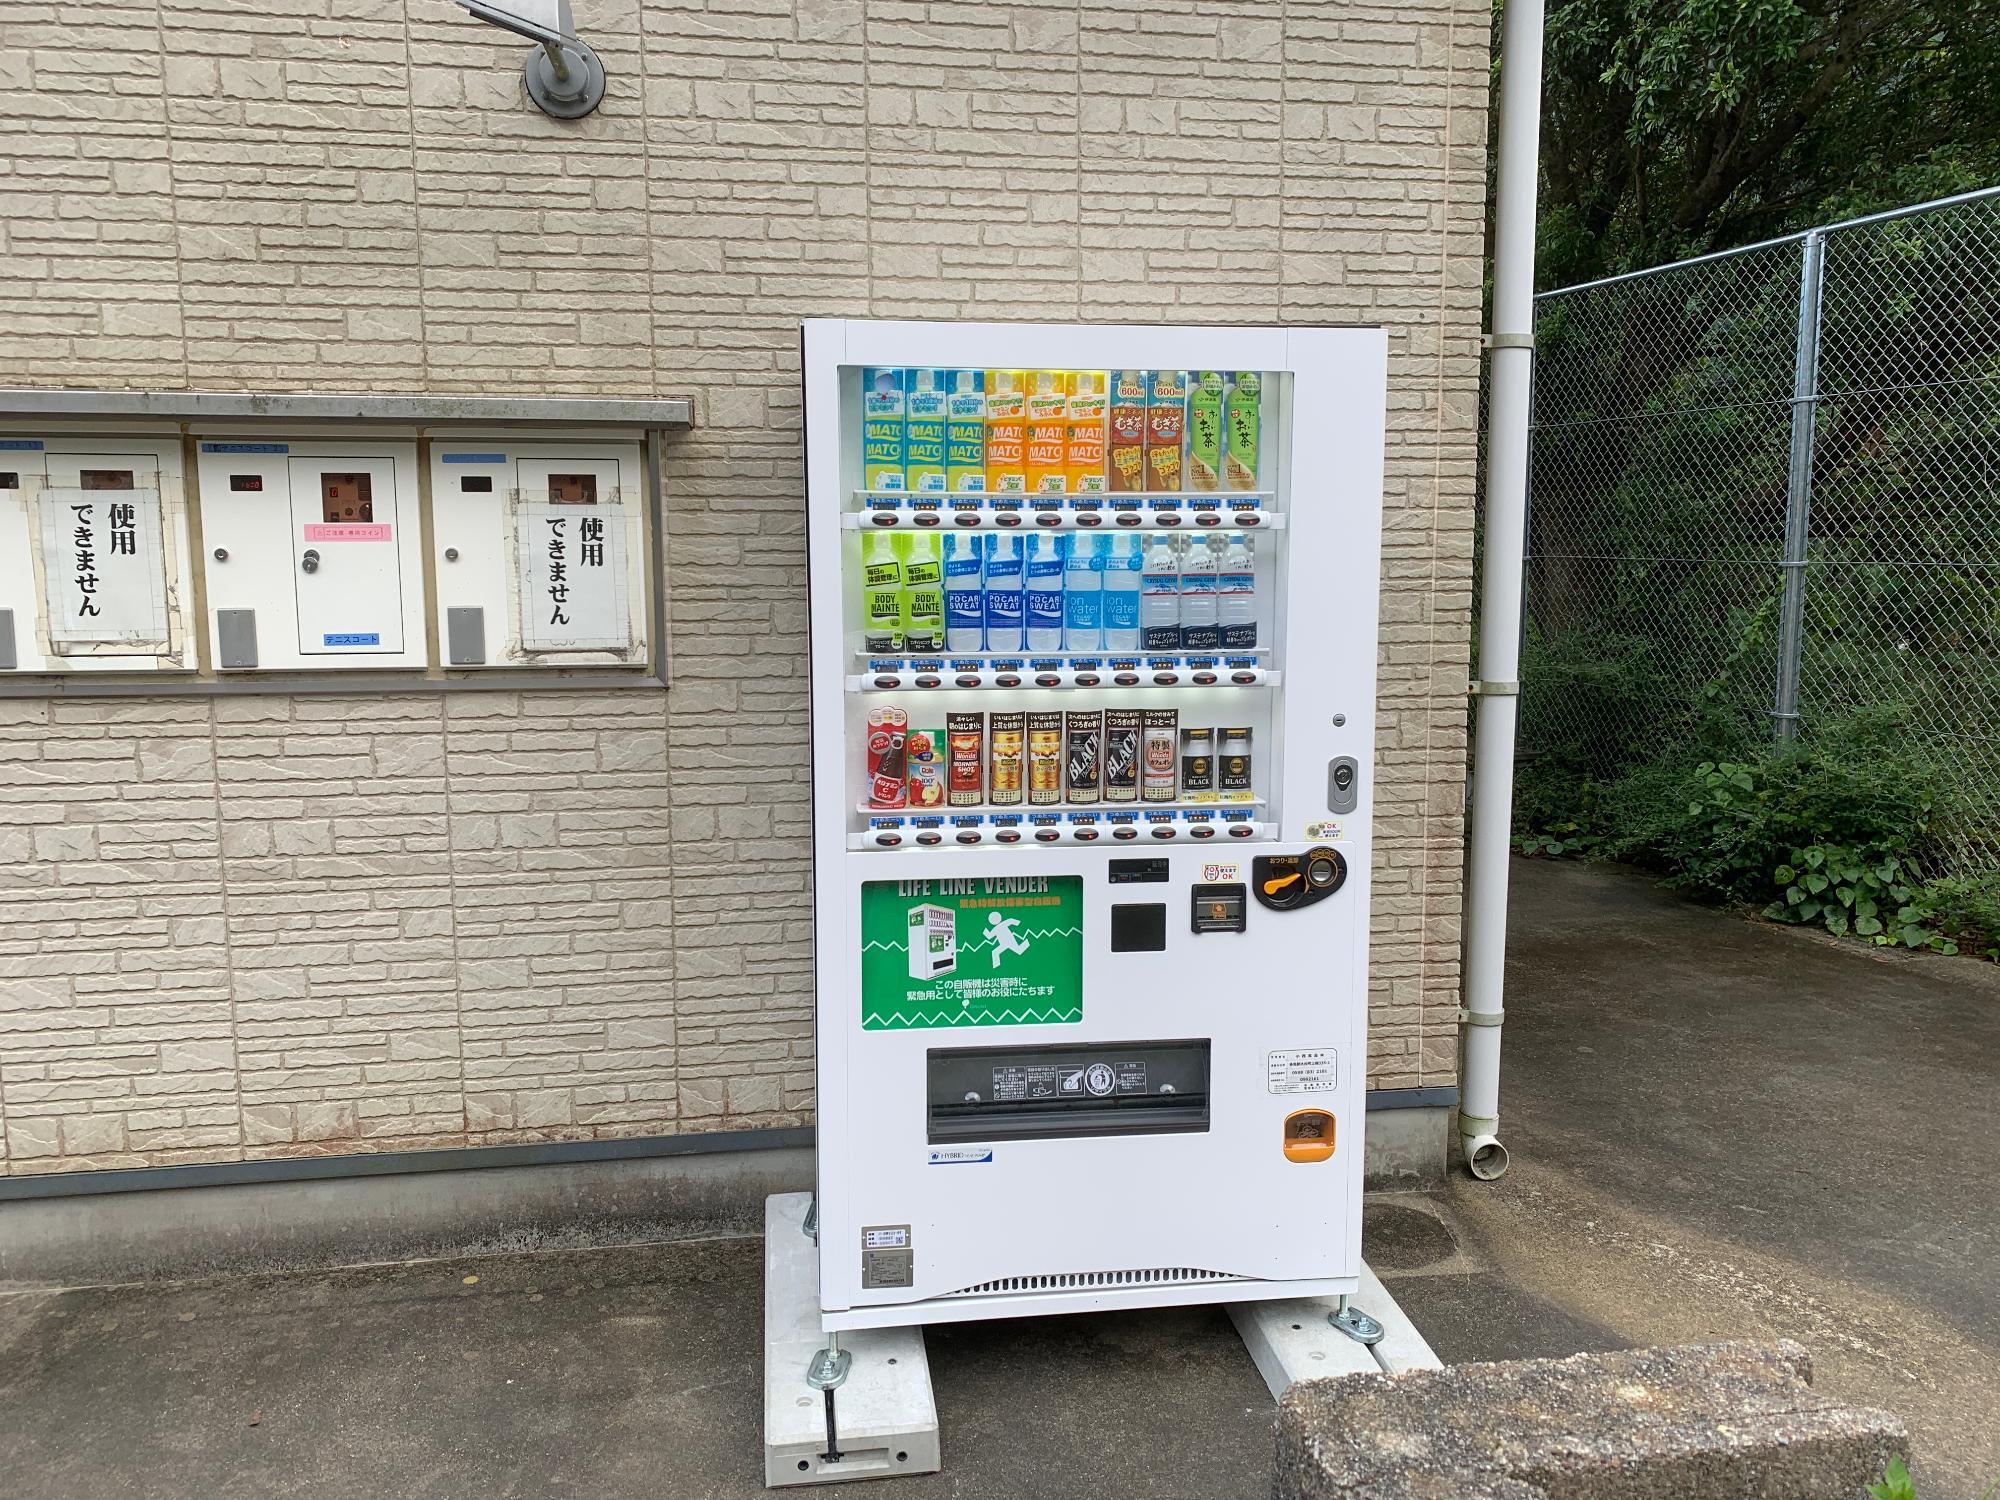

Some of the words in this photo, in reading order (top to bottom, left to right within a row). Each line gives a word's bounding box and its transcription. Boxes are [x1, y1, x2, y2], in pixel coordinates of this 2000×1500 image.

[1115, 417, 1143, 431] むぎ茶
[1151, 417, 1180, 431] むぎ茶
[1200, 419, 1216, 448] お茶
[1236, 419, 1253, 448] お茶
[108, 503, 136, 555] 使用
[579, 517, 604, 567] 使用
[71, 504, 101, 617] できません
[545, 518, 570, 625] できません
[908, 567, 925, 575] 毎日の
[868, 574, 898, 583] 体調管理に
[909, 573, 938, 582] 体調管理に
[875, 595, 896, 603] BODY
[915, 594, 936, 603] BODY
[949, 602, 979, 610] SWEAT
[989, 602, 1020, 610] SWEAT
[1029, 602, 1060, 610] SWEAT
[325, 634, 377, 645] テニスコート
[1068, 720, 1100, 729] くつろぎの香り
[1107, 718, 1140, 726] くつろぎの香り
[1145, 718, 1176, 726] ほっと一息
[1151, 740, 1170, 751] 特製
[1069, 732, 1100, 782] BLACK
[1107, 730, 1138, 780] BLACK
[898, 879, 931, 897] LIFE
[940, 878, 976, 896] LINE
[983, 876, 1049, 894] VENDER
[935, 977, 1028, 990] この自販機は災害時に
[907, 986, 1055, 1001] 緊急用として皆様のお役にたちます
